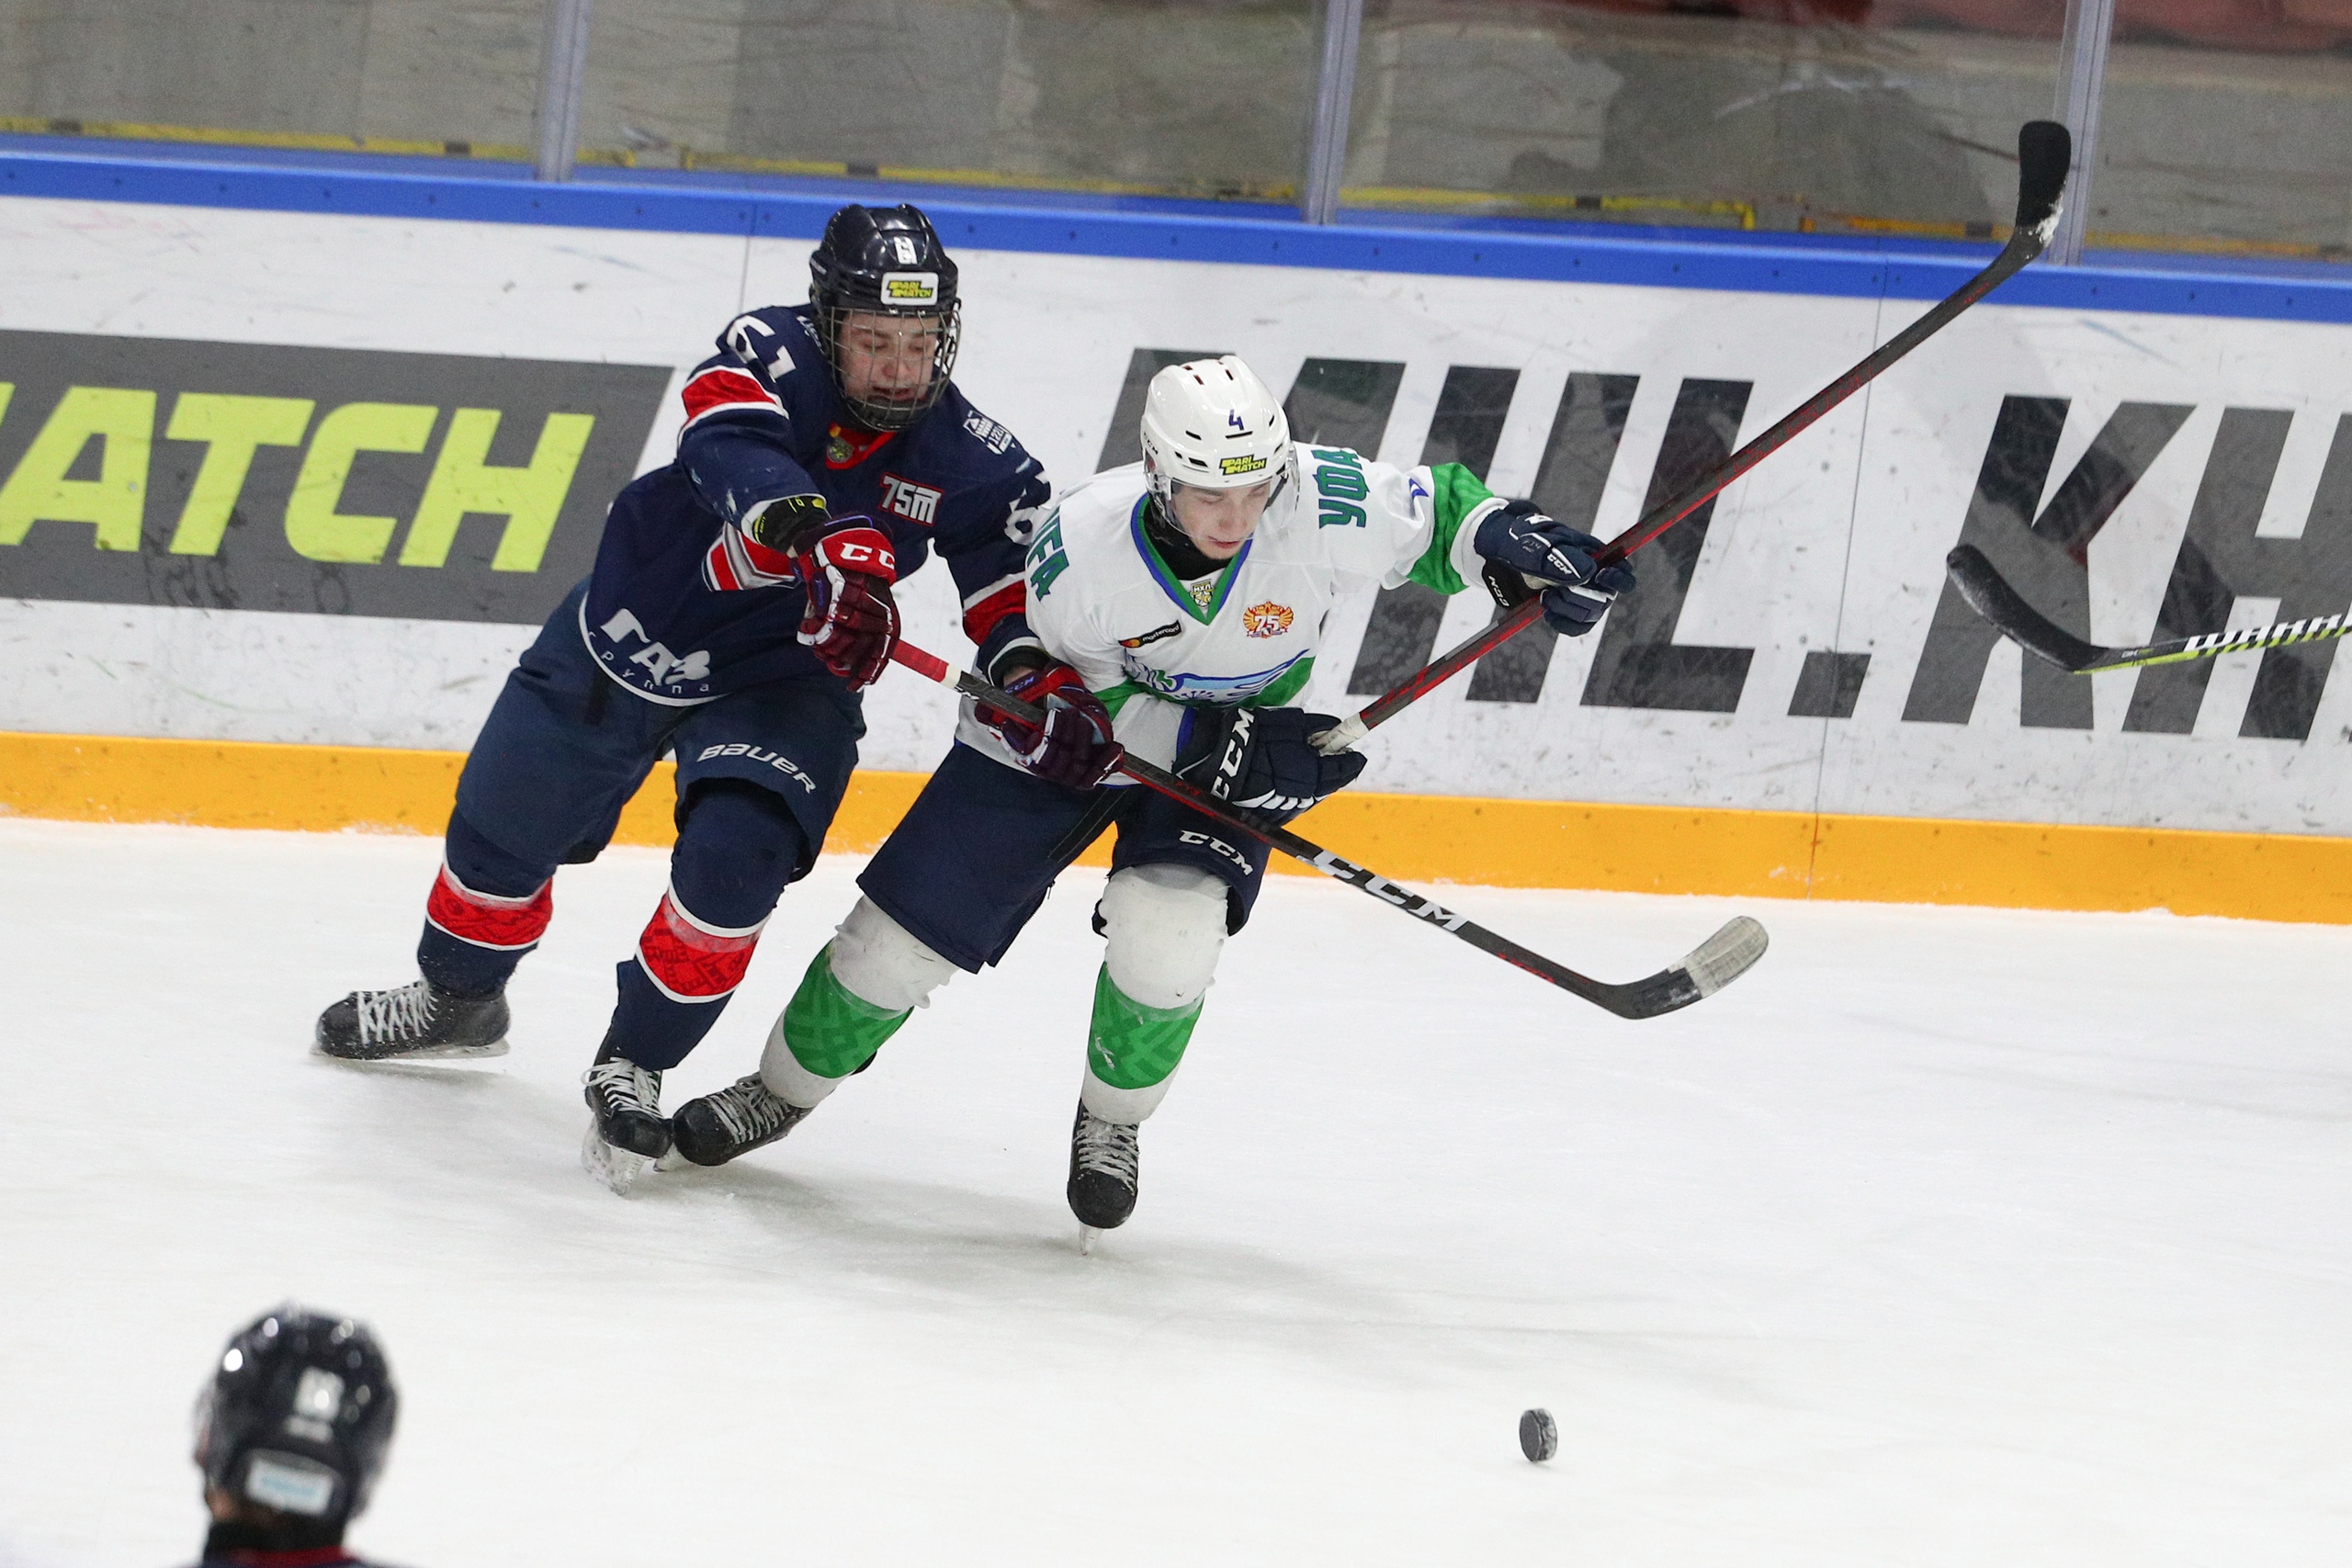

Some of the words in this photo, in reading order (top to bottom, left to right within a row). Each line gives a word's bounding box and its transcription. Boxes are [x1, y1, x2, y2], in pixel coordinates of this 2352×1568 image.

[1228, 409, 1245, 431] 4
[1225, 456, 1252, 466] PARI
[1228, 459, 1265, 473] MATCH
[0, 381, 595, 573] ATCH
[1311, 449, 1370, 529] УФА
[840, 542, 895, 570] CC
[1546, 553, 1573, 575] CCM
[1142, 626, 1181, 642] mastercard
[1254, 615, 1280, 633] 75
[1210, 707, 1255, 801] CCM
[1179, 829, 1253, 875] CCM
[1313, 849, 1470, 932] CCM
